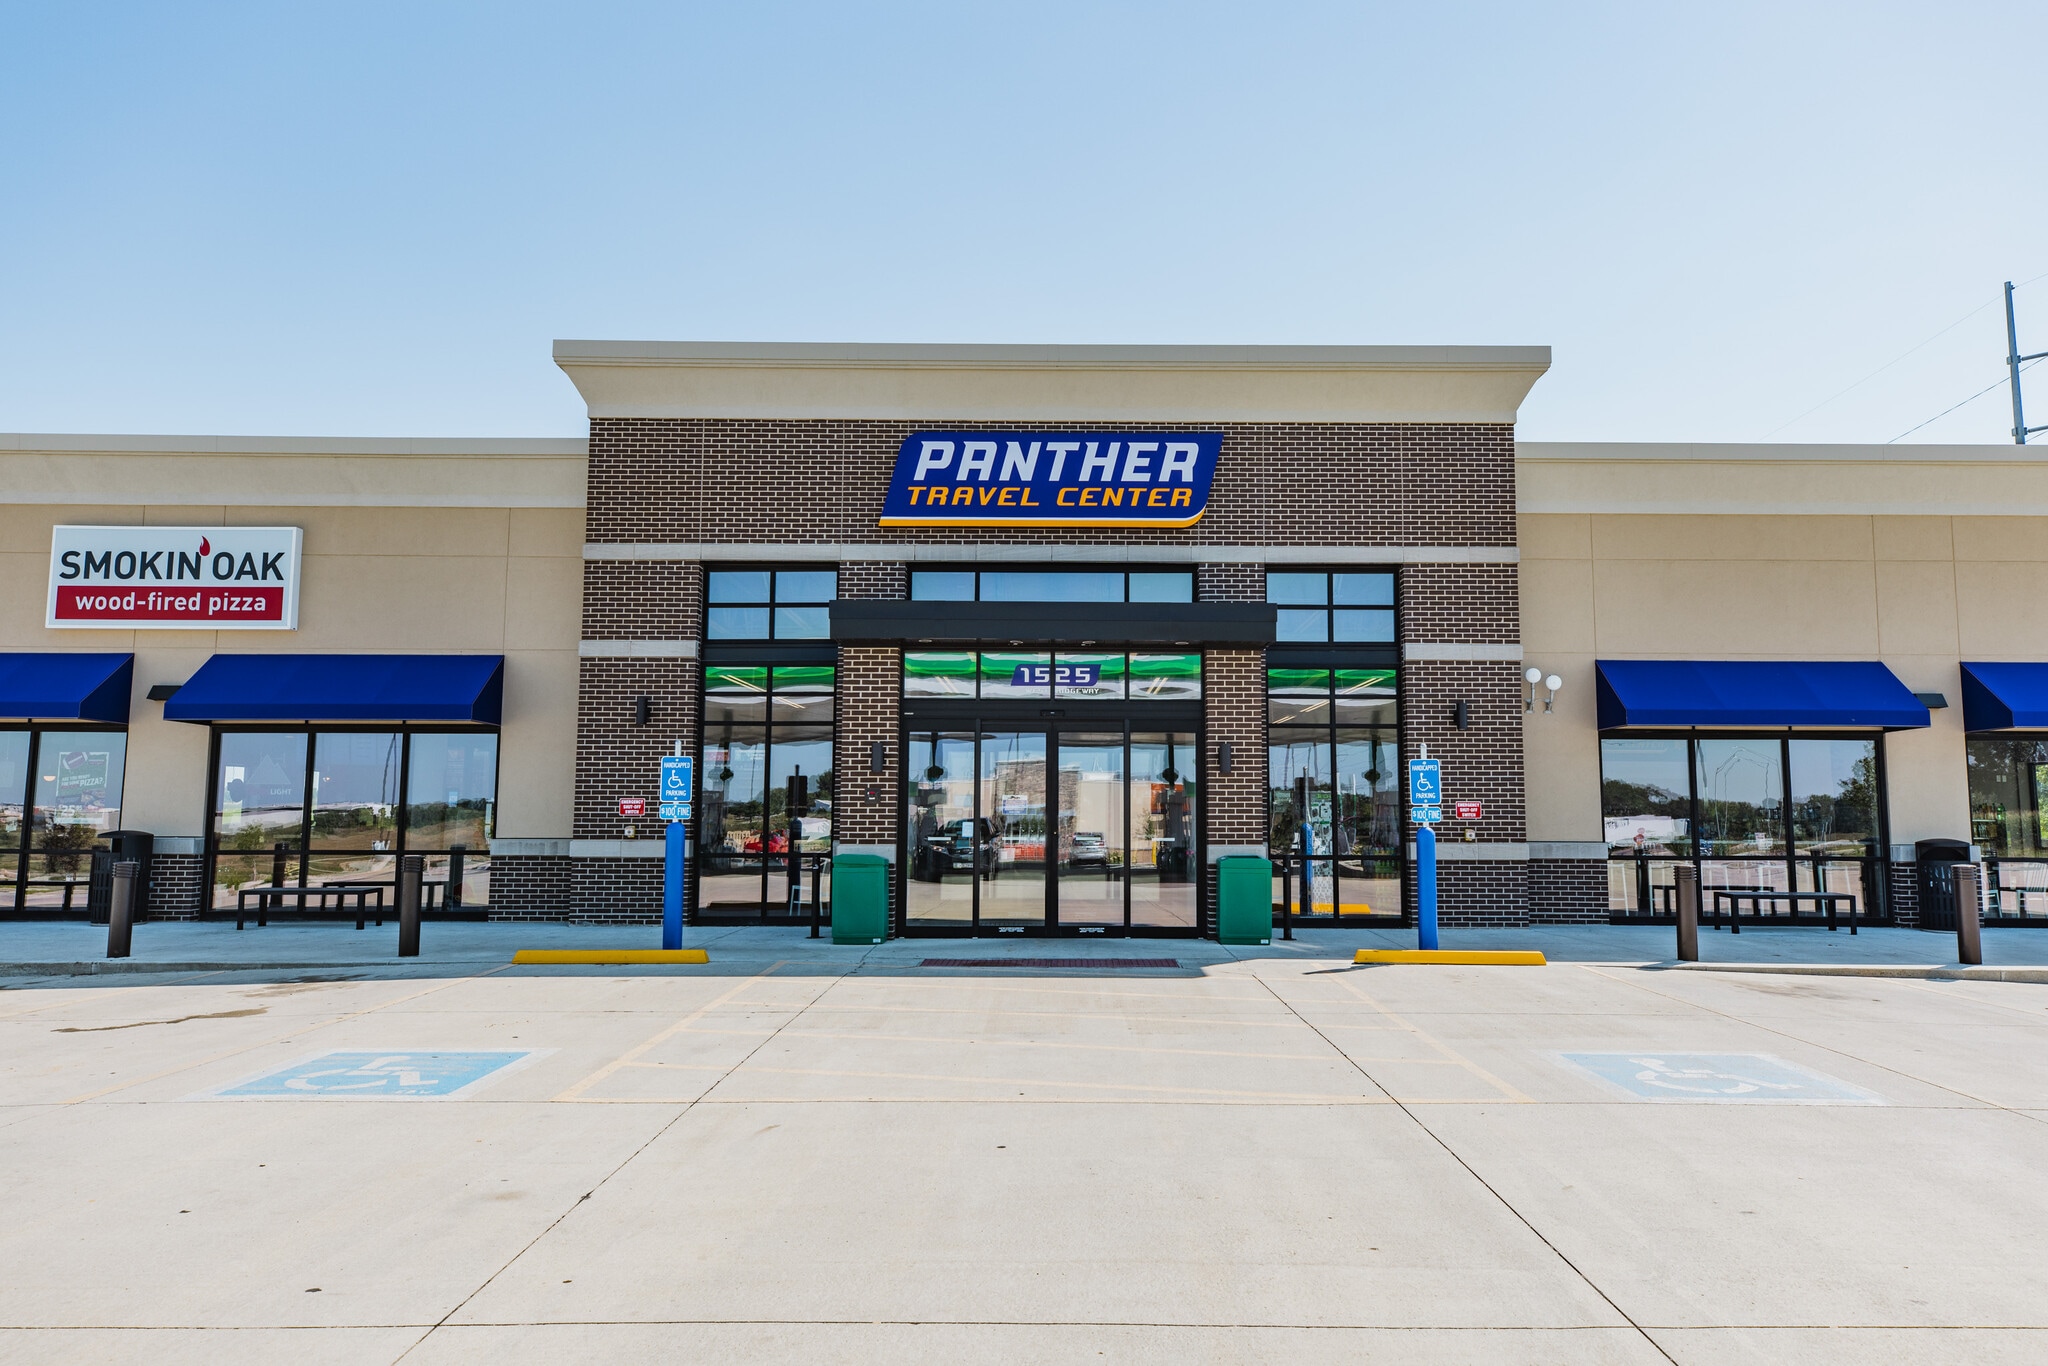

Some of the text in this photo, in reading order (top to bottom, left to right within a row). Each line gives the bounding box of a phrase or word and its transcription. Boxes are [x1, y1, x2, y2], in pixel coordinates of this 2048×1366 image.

[913, 441, 1199, 482] PANTHER
[907, 486, 1192, 507] TRAVEL CENTER
[212, 551, 285, 580] OAK
[75, 592, 266, 615] wood-fired pizza
[1020, 667, 1091, 683] 1525
[661, 807, 690, 816] $100 FINE
[1413, 810, 1440, 819] $100 FINE
